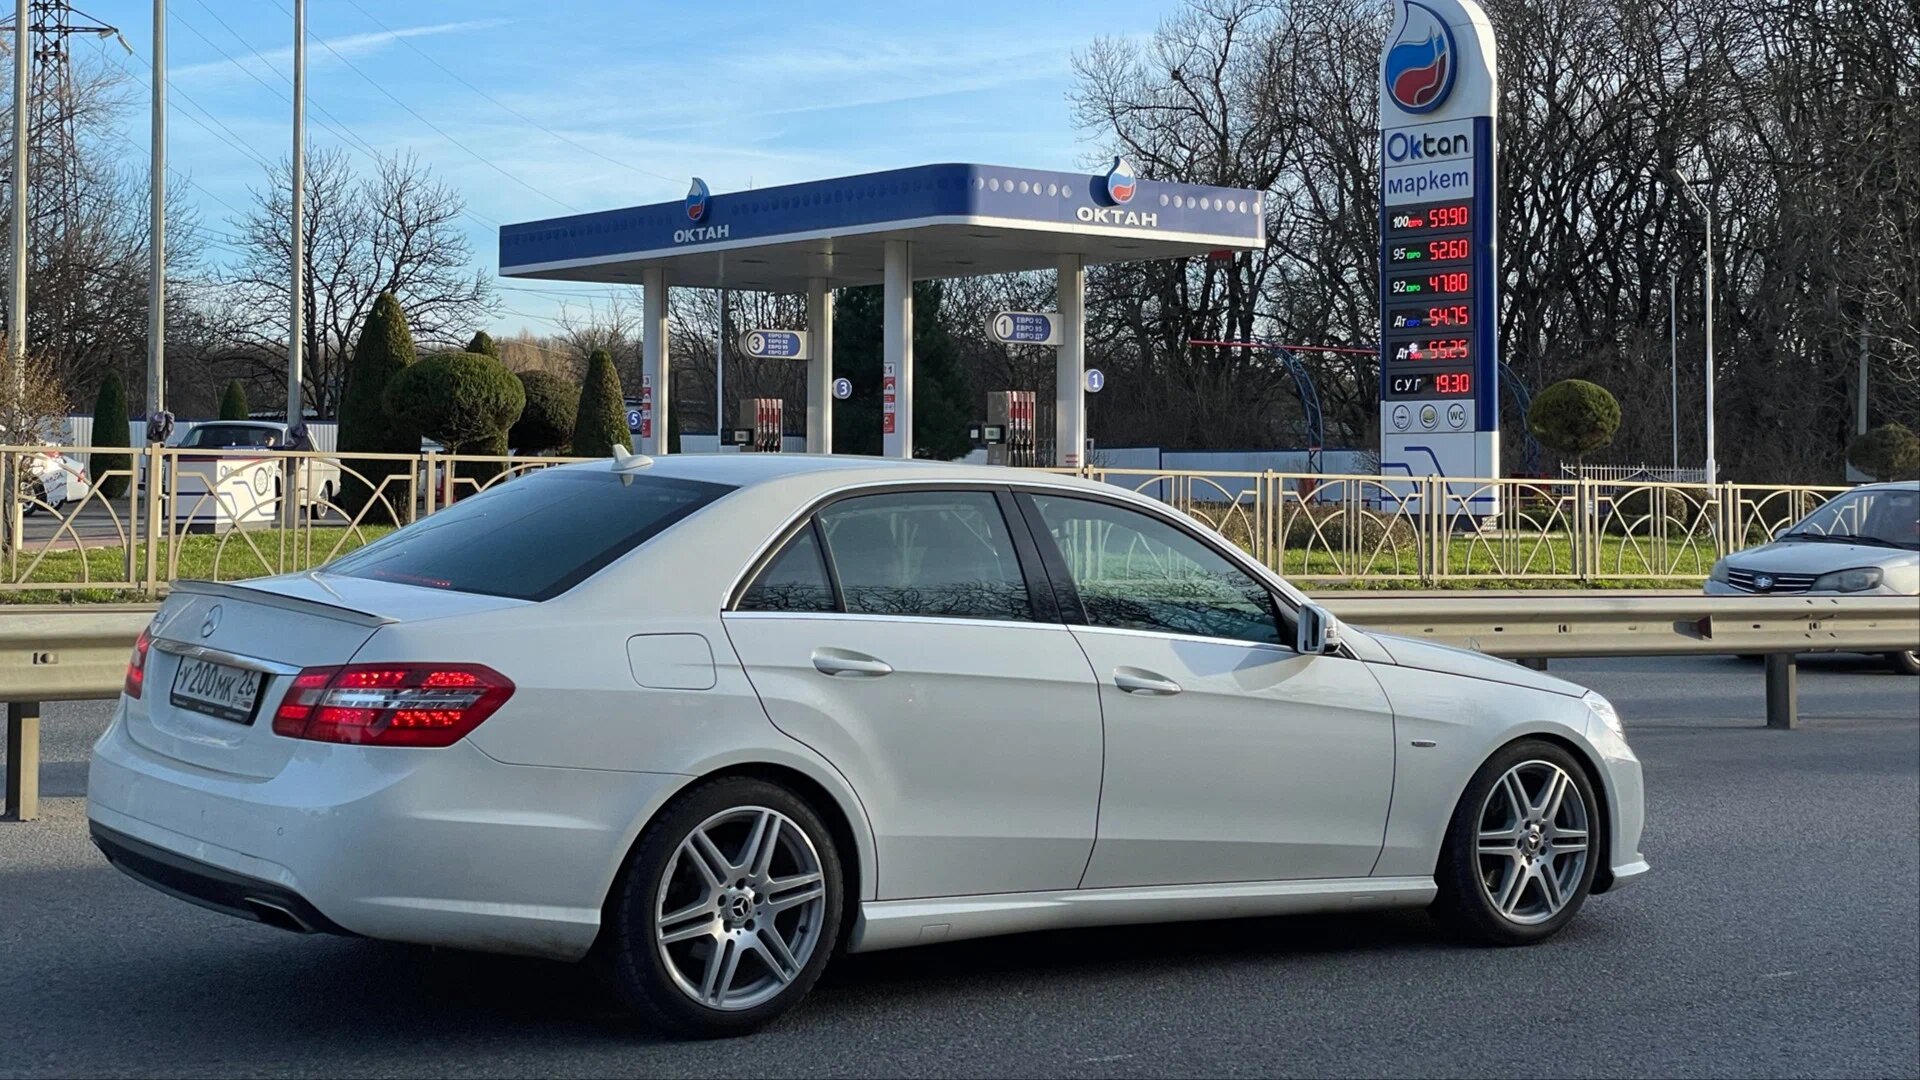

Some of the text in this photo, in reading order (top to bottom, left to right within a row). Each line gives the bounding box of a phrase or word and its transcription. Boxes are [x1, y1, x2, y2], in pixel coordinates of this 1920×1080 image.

[1387, 132, 1469, 162] Oktan
[1076, 206, 1158, 227] ОКТАН
[1393, 215, 1409, 229] 100
[1429, 206, 1468, 228] 59.90
[673, 224, 730, 243] ОКТАН
[1393, 248, 1406, 260] 95
[1429, 239, 1468, 260] 52.60
[1393, 280, 1406, 293] 92
[1429, 273, 1468, 292] 47.80
[1429, 306, 1468, 327] 54.75
[1000, 319, 1007, 335] 1
[752, 336, 760, 350] 3
[1429, 340, 1468, 359] 55.25
[840, 382, 848, 395] 3
[1092, 374, 1099, 388] 1
[1394, 374, 1469, 393] СУГ 19.30
[630, 413, 638, 426] 5
[1450, 411, 1464, 421] WC
